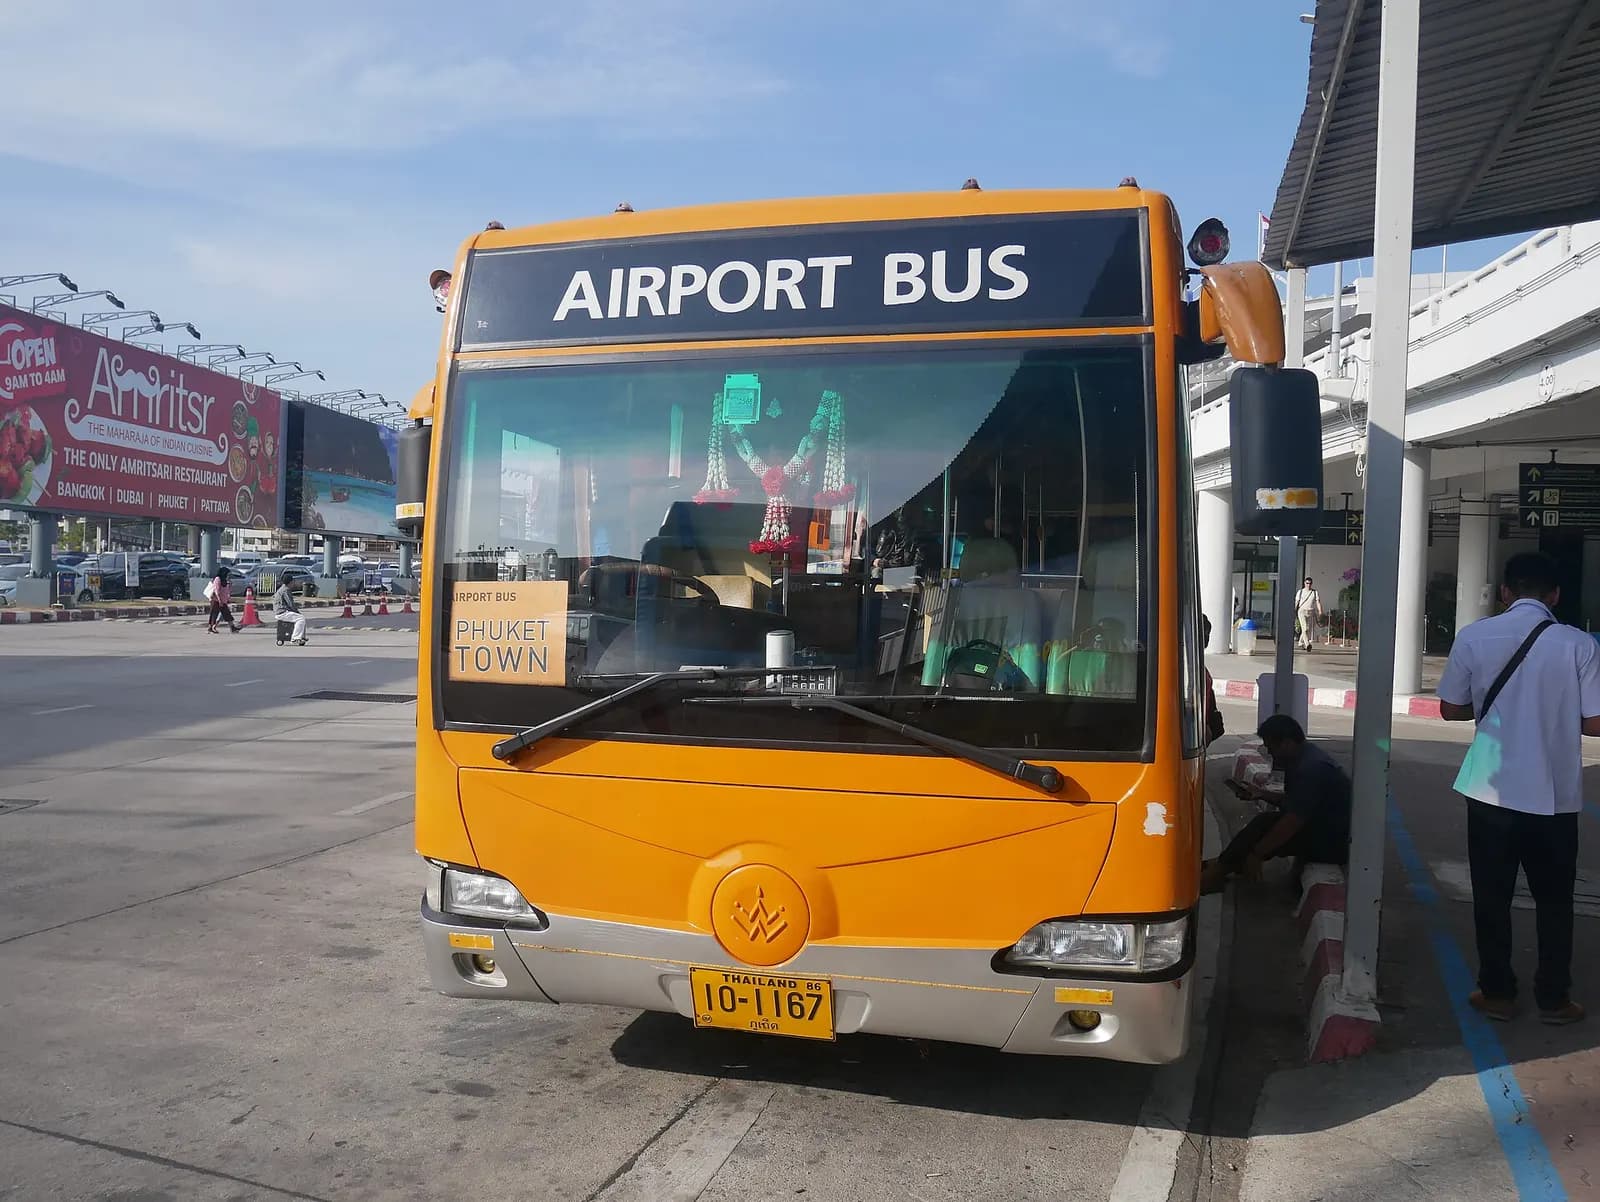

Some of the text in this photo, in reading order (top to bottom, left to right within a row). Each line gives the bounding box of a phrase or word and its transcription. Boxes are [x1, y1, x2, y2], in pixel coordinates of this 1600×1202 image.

[553, 244, 1029, 321] AIRPORT BUS
[11, 337, 57, 371] OPEN
[5, 368, 66, 391] 9AM TO 4AM
[87, 347, 215, 435] Amritsr
[88, 421, 213, 457] THE MAHARAJA OF INDIAN CUISINE
[64, 447, 228, 488] THE ONLY AMRITSARI RESTAURANT
[57, 481, 230, 514] BANGKOK DUBAI PHUKET PATTAYA
[452, 592, 517, 602] IRPORT BUS
[456, 620, 550, 641] PHUKET
[454, 645, 548, 673] TOWN
[722, 973, 822, 991] THAILAND 86
[705, 983, 823, 1021] 10-1167
